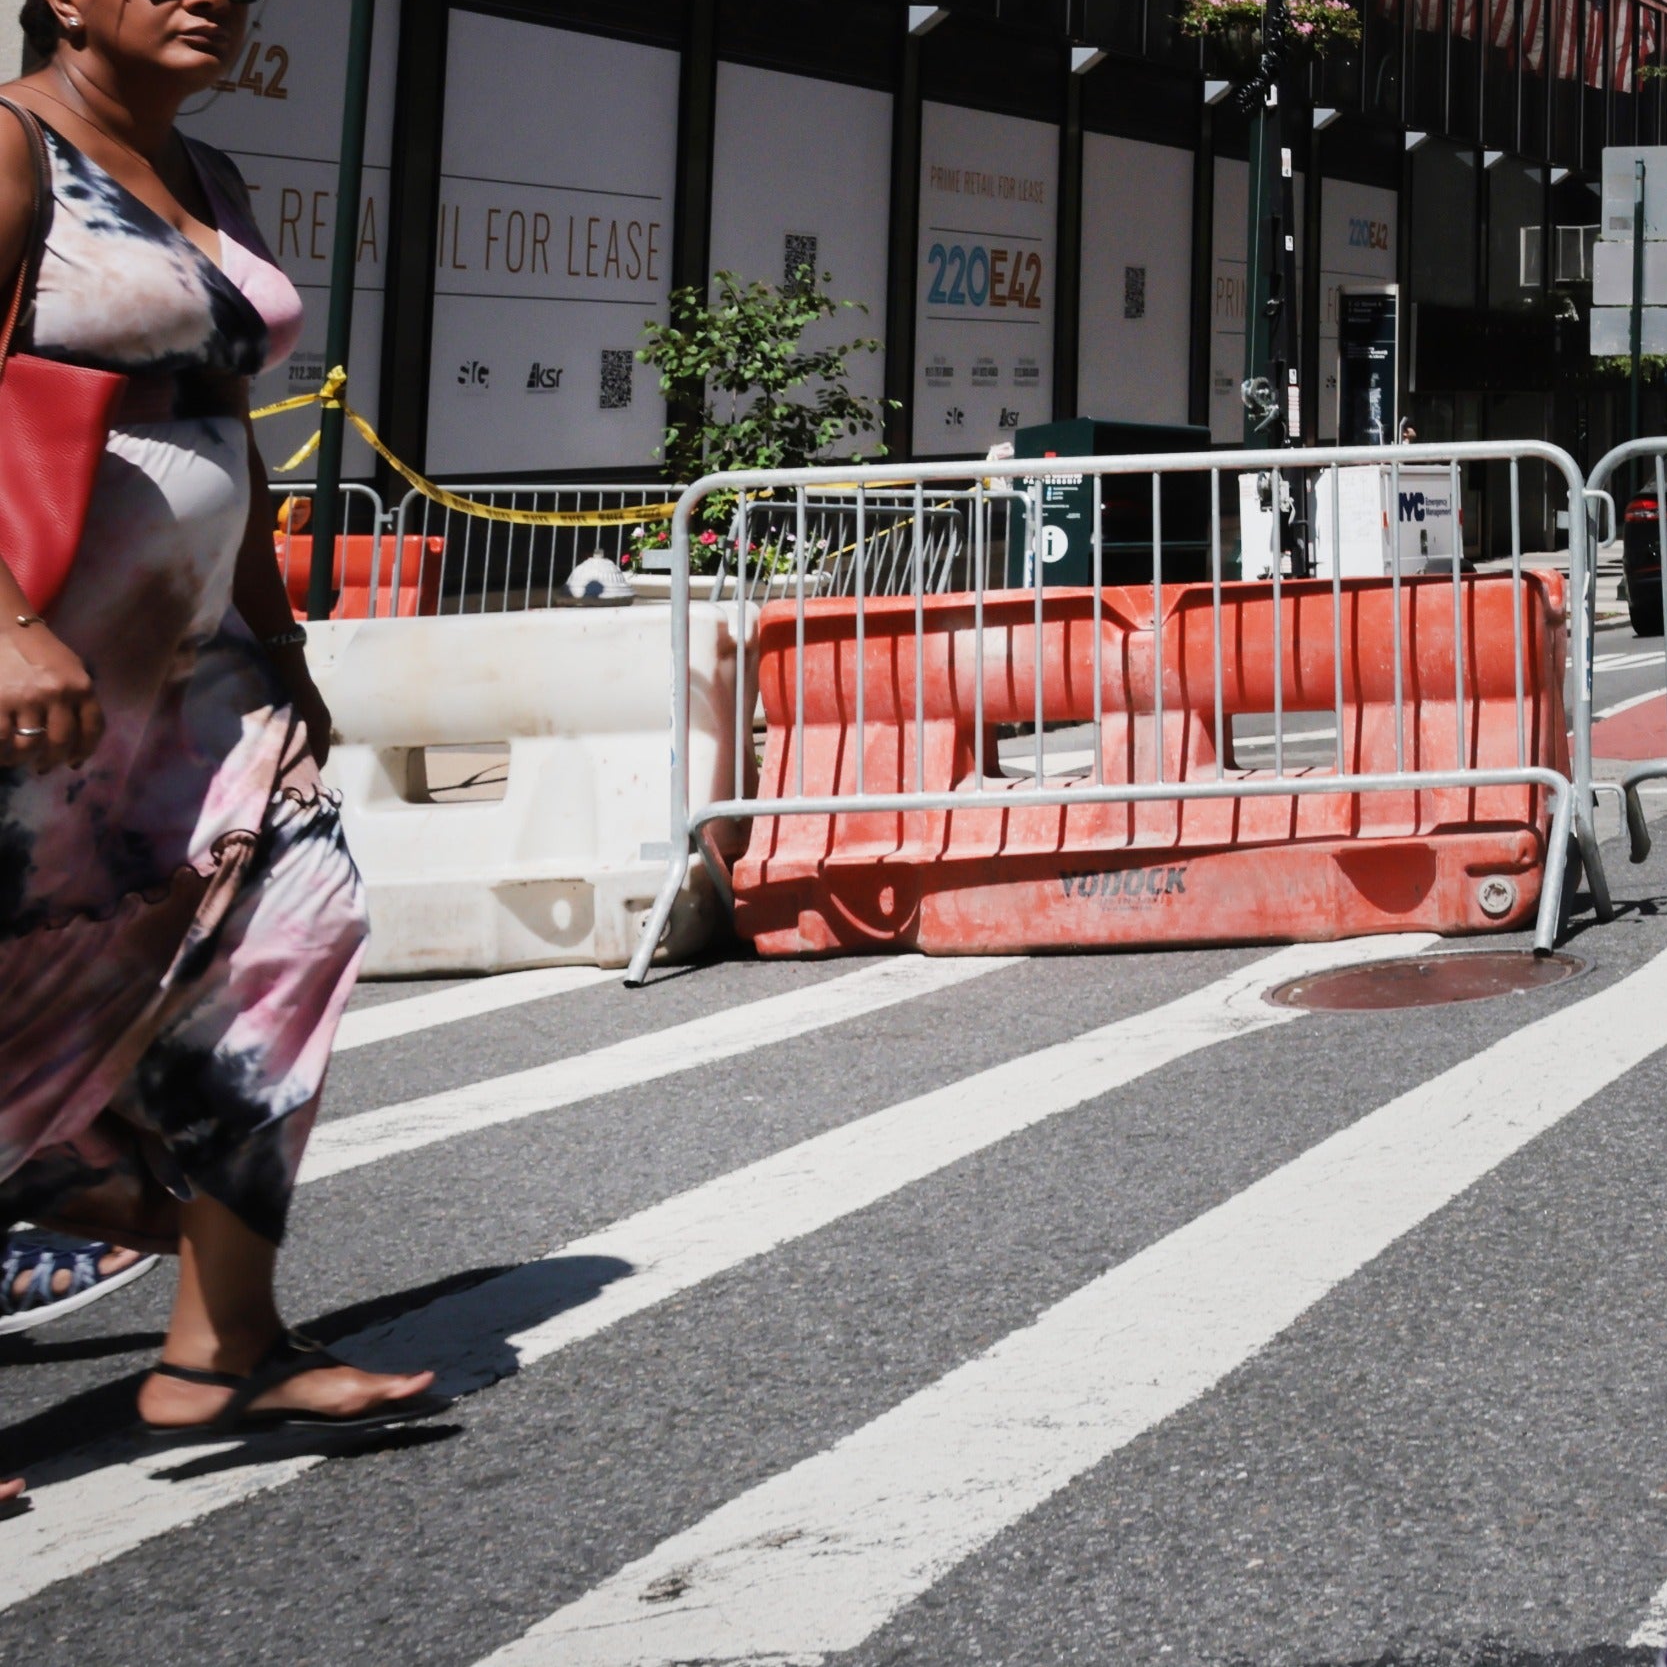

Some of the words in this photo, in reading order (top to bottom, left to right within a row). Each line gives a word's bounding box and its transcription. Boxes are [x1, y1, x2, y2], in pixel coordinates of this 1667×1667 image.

[930, 165, 961, 193] PRIME
[963, 170, 995, 198] RETAIL
[998, 175, 1016, 200] FOR
[1018, 179, 1044, 204] LEASE
[486, 208, 551, 274] FOR
[568, 216, 661, 281] LEASE
[1349, 218, 1388, 251] 220E42
[928, 243, 1042, 309] 220E42
